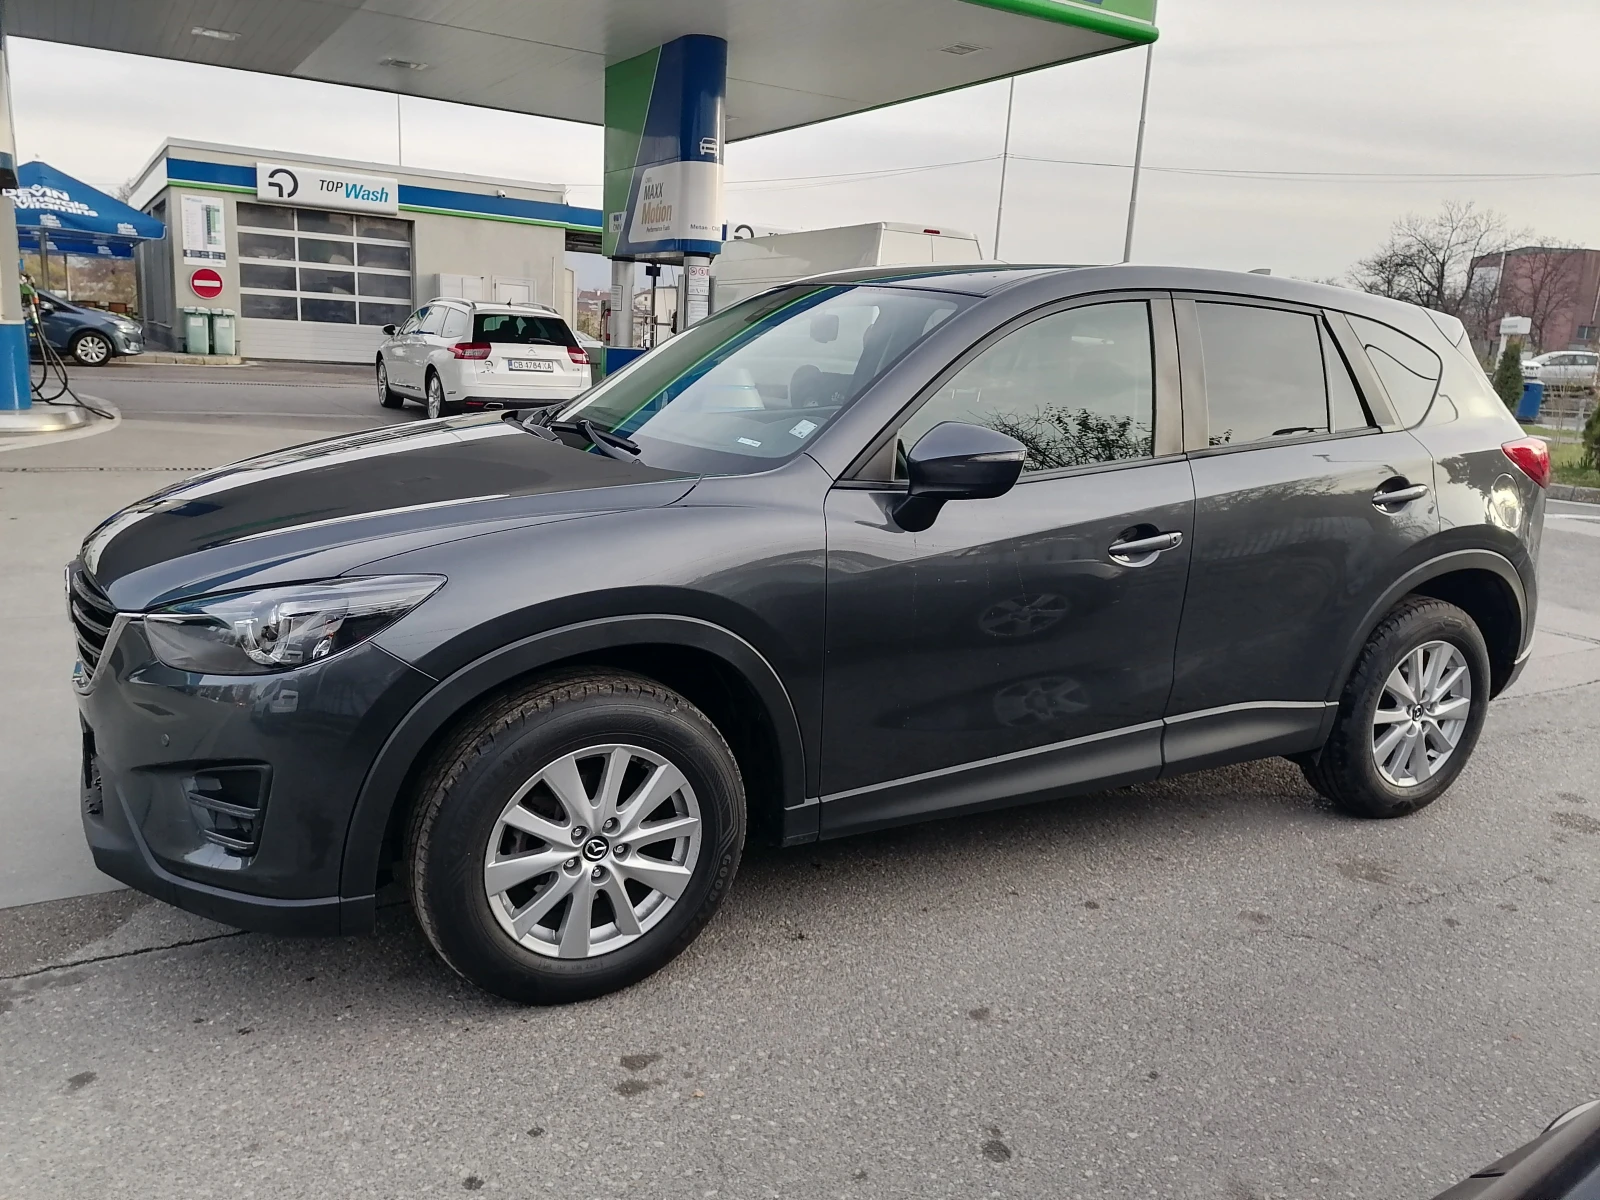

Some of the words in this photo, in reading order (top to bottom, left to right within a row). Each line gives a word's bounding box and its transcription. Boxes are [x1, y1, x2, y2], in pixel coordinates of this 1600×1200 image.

[2, 184, 70, 201] DEVIN
[319, 179, 343, 193] TOP
[345, 182, 389, 203] Wash
[643, 182, 664, 201] MAXX
[9, 195, 90, 210] Minerals
[16, 201, 99, 217] Vitamins
[641, 200, 673, 225] Motion
